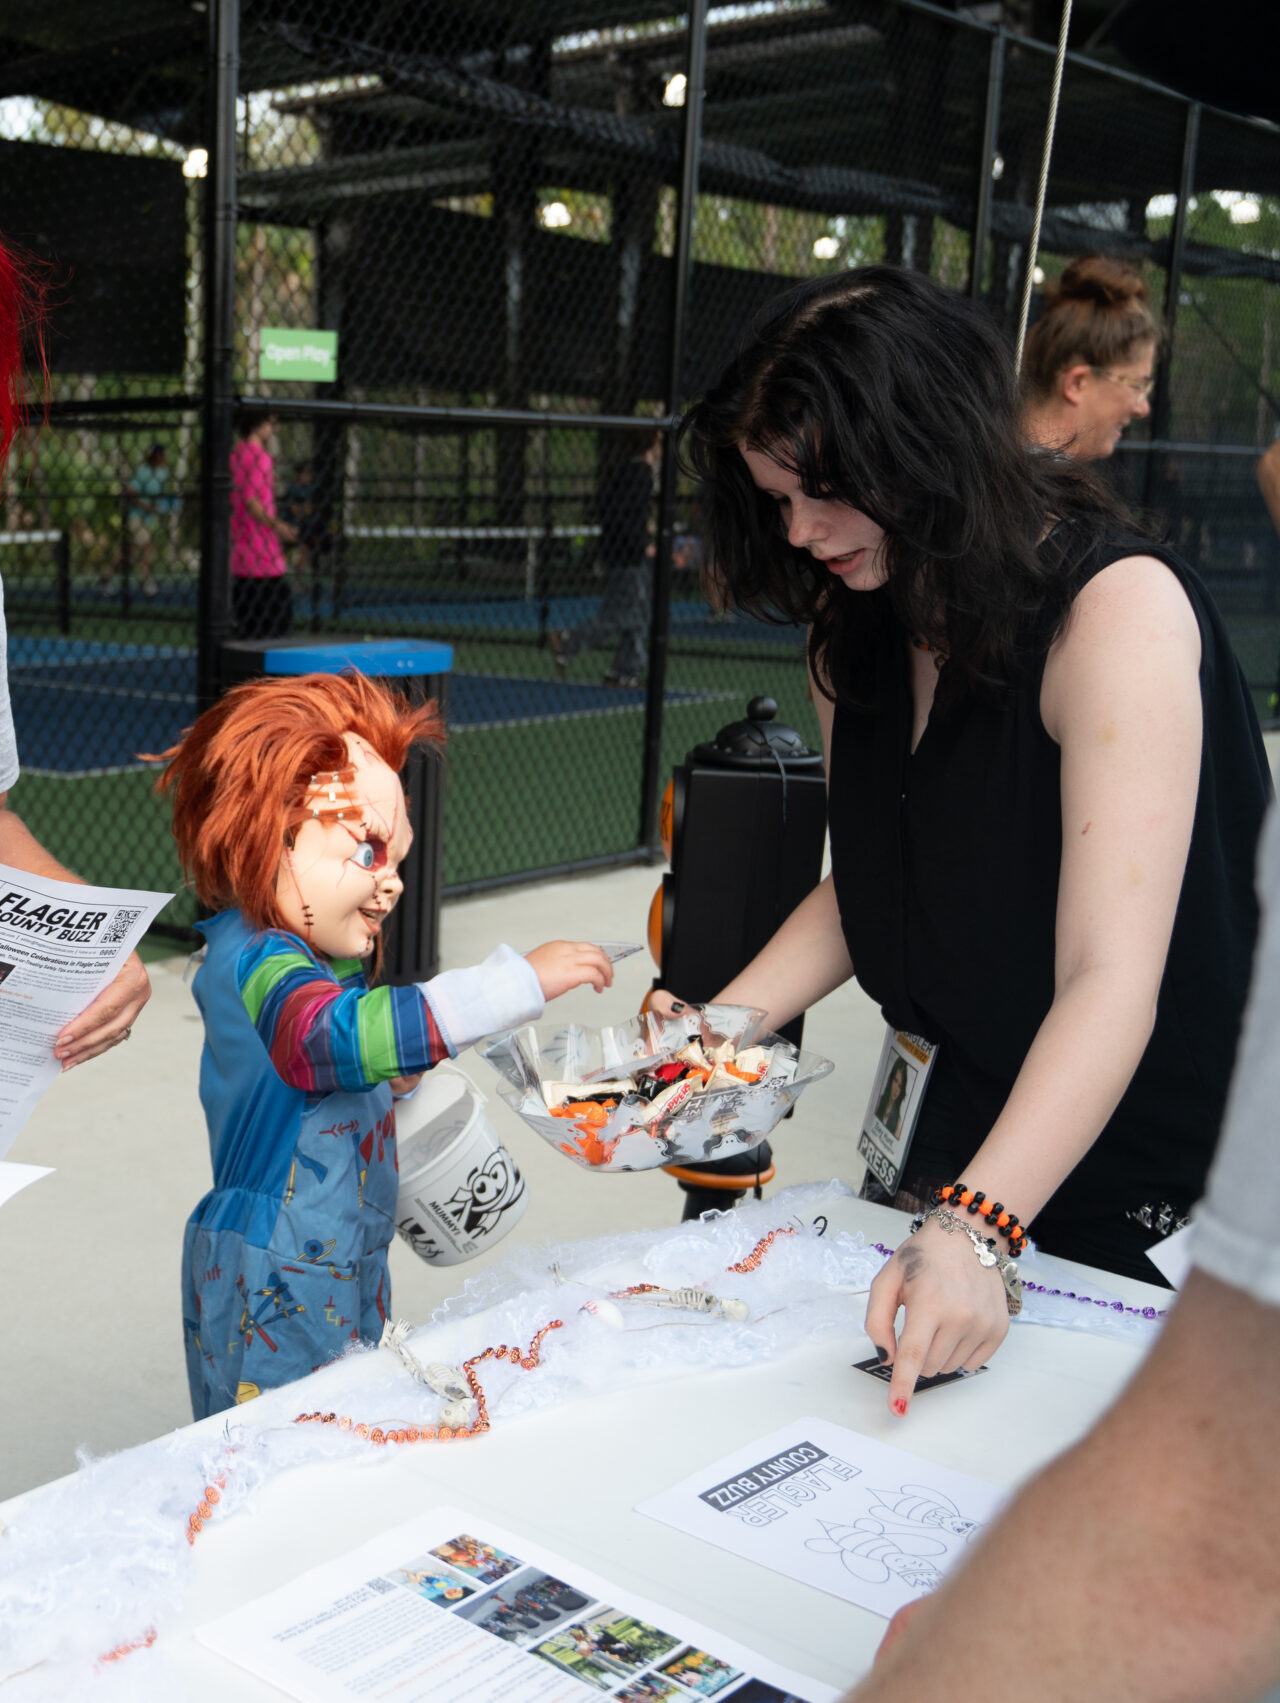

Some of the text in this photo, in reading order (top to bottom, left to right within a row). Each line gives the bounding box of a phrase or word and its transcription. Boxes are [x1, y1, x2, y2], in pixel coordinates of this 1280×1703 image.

[266, 343, 300, 366] Open
[57, 929, 96, 943] BUZZ
[30, 952, 71, 967] Celebrations
[76, 961, 94, 969] Flagler
[859, 1135, 896, 1187] PRESS
[429, 1200, 461, 1236] MUMMY!
[707, 1447, 820, 1507] COUNTY BUZZ
[726, 1456, 863, 1527] FLAGLER
